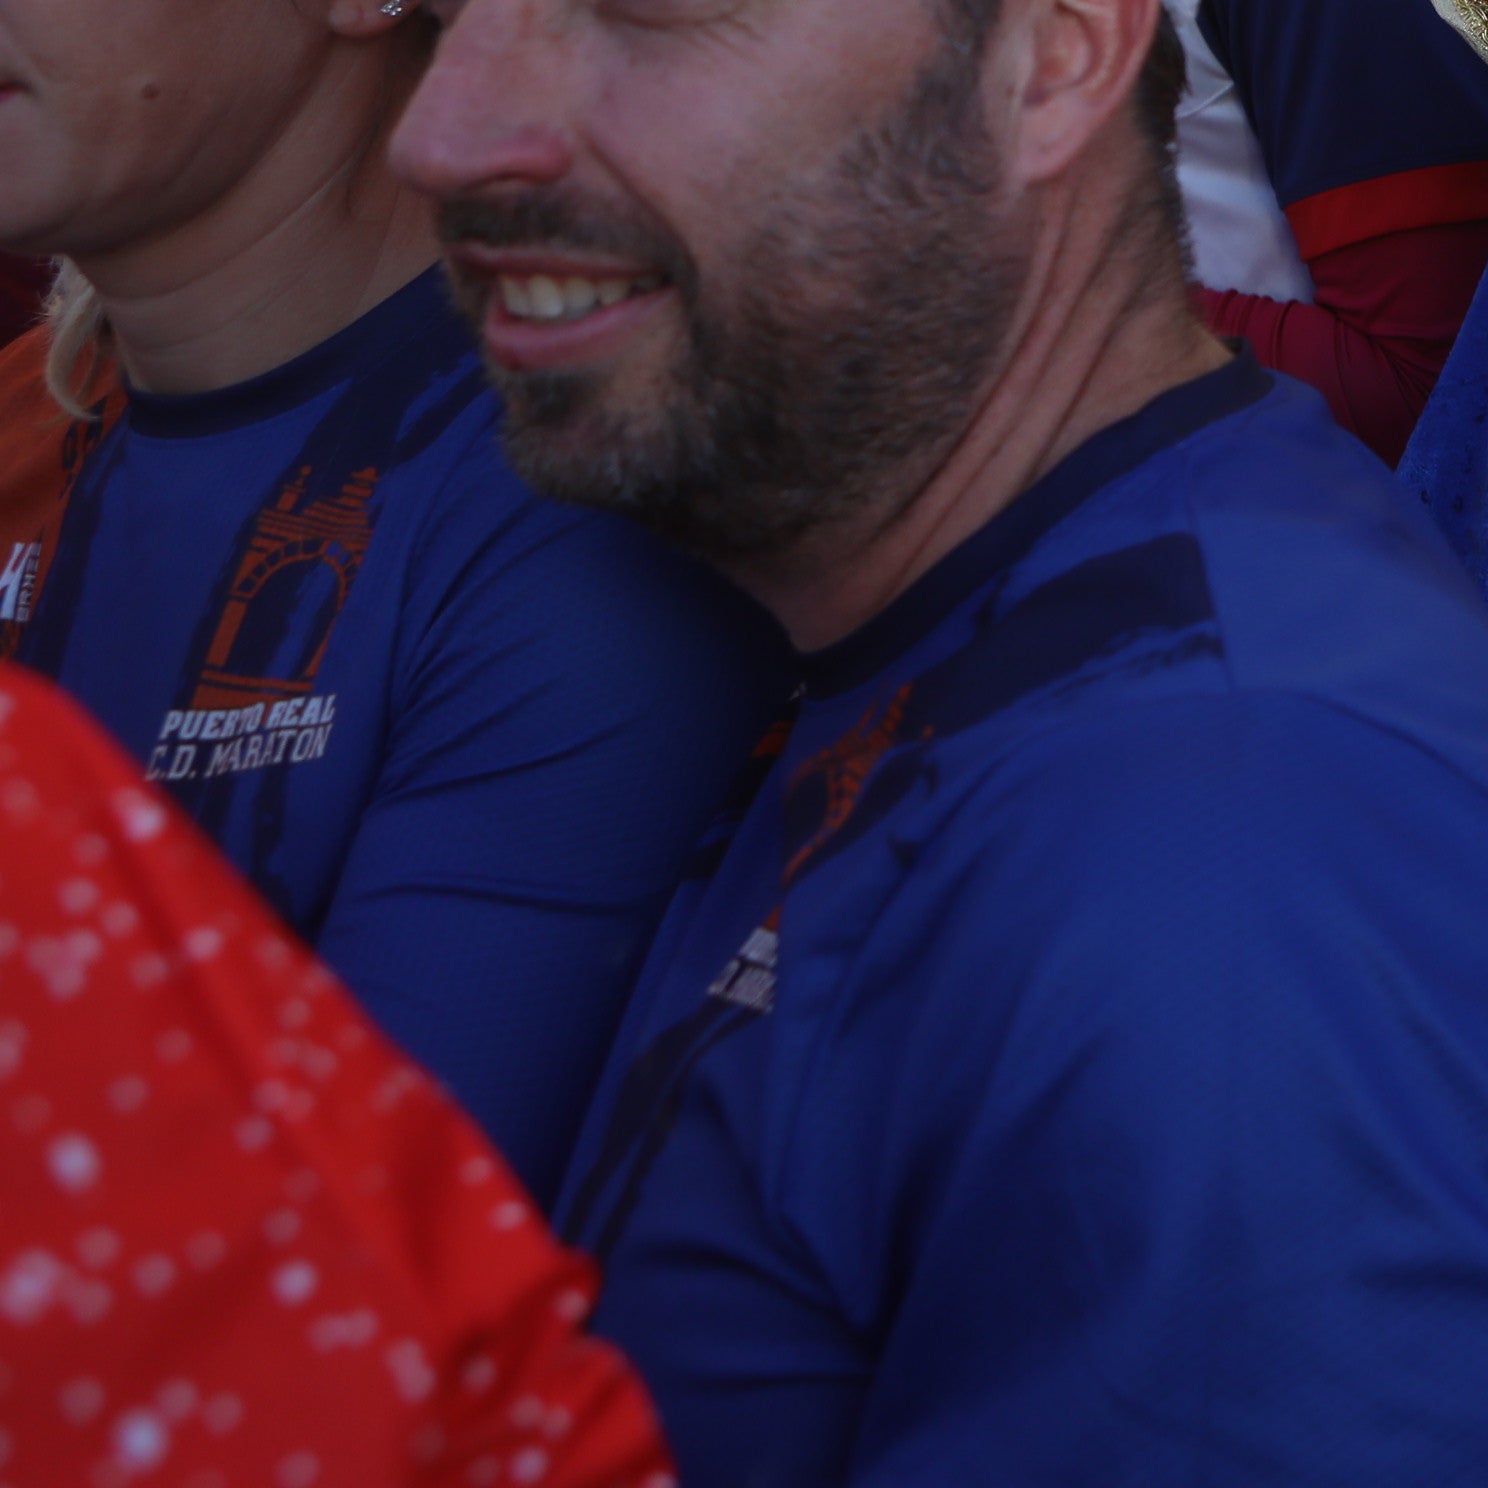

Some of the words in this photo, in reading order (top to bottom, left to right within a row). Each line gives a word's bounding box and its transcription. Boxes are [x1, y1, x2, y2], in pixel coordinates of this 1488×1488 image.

[159, 701, 266, 741] PUERTO
[266, 694, 336, 730] REAL
[204, 722, 333, 778] MARATON
